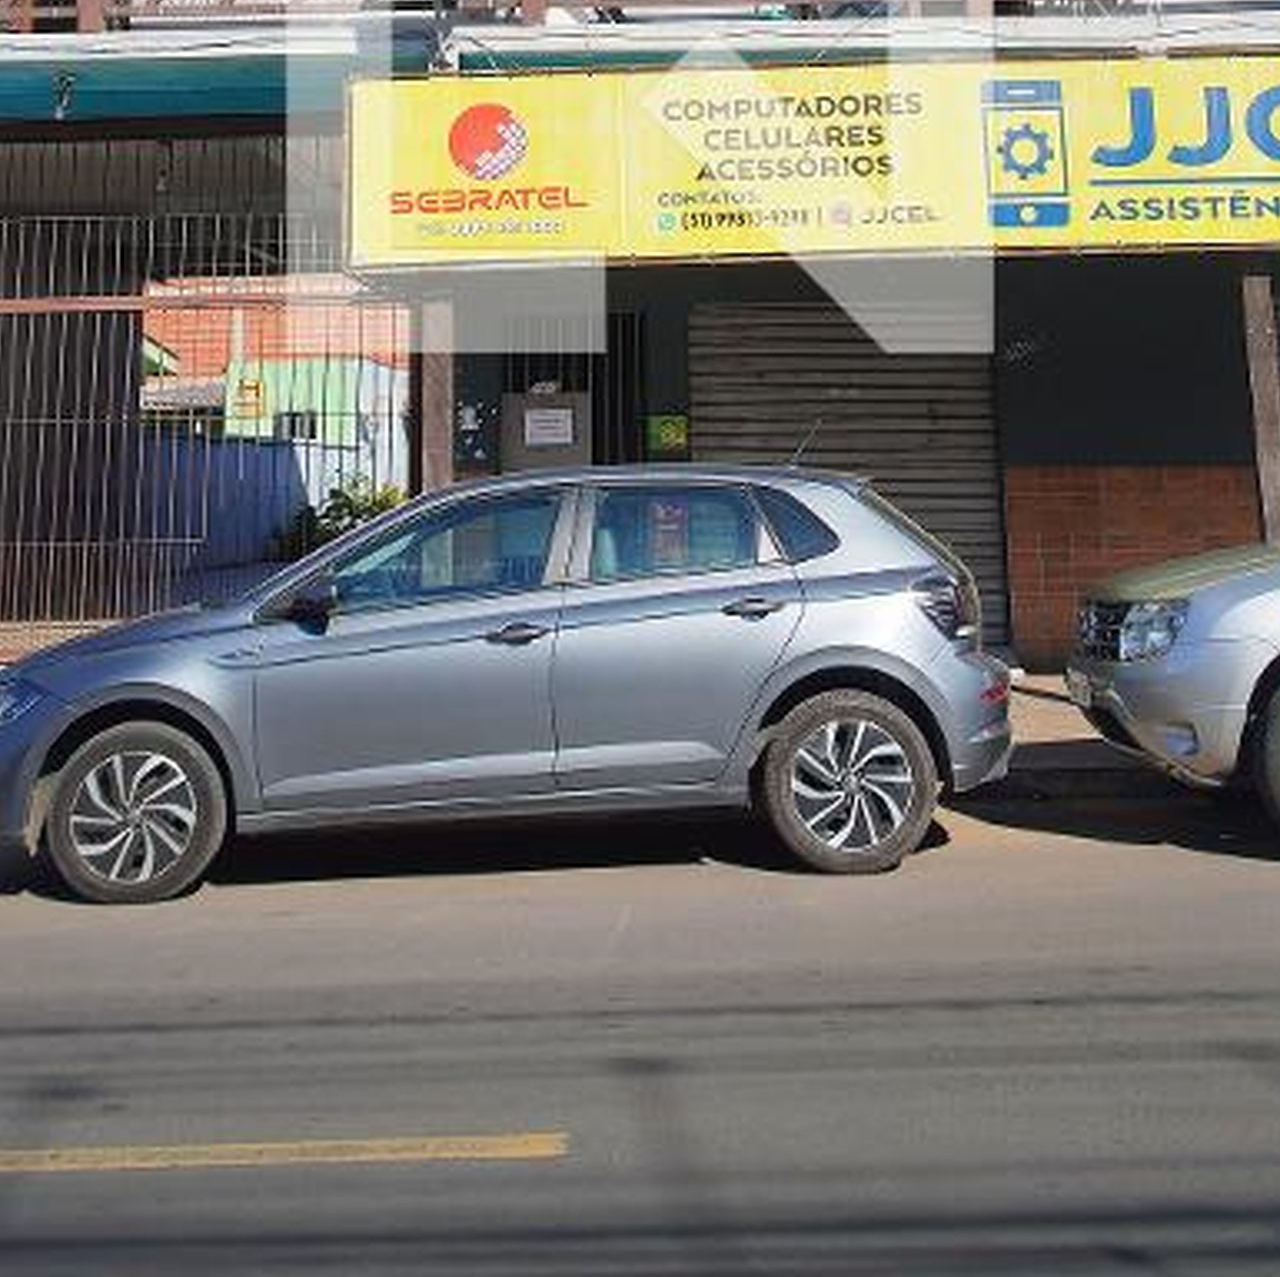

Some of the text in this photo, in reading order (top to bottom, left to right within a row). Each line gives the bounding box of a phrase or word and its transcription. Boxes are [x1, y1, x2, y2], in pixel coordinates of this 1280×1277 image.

[663, 92, 923, 122] COMPUTADORES
[703, 125, 885, 151] CELULARES
[696, 150, 894, 181] ACESSÓRIOS
[390, 186, 590, 214] SEBRATEL
